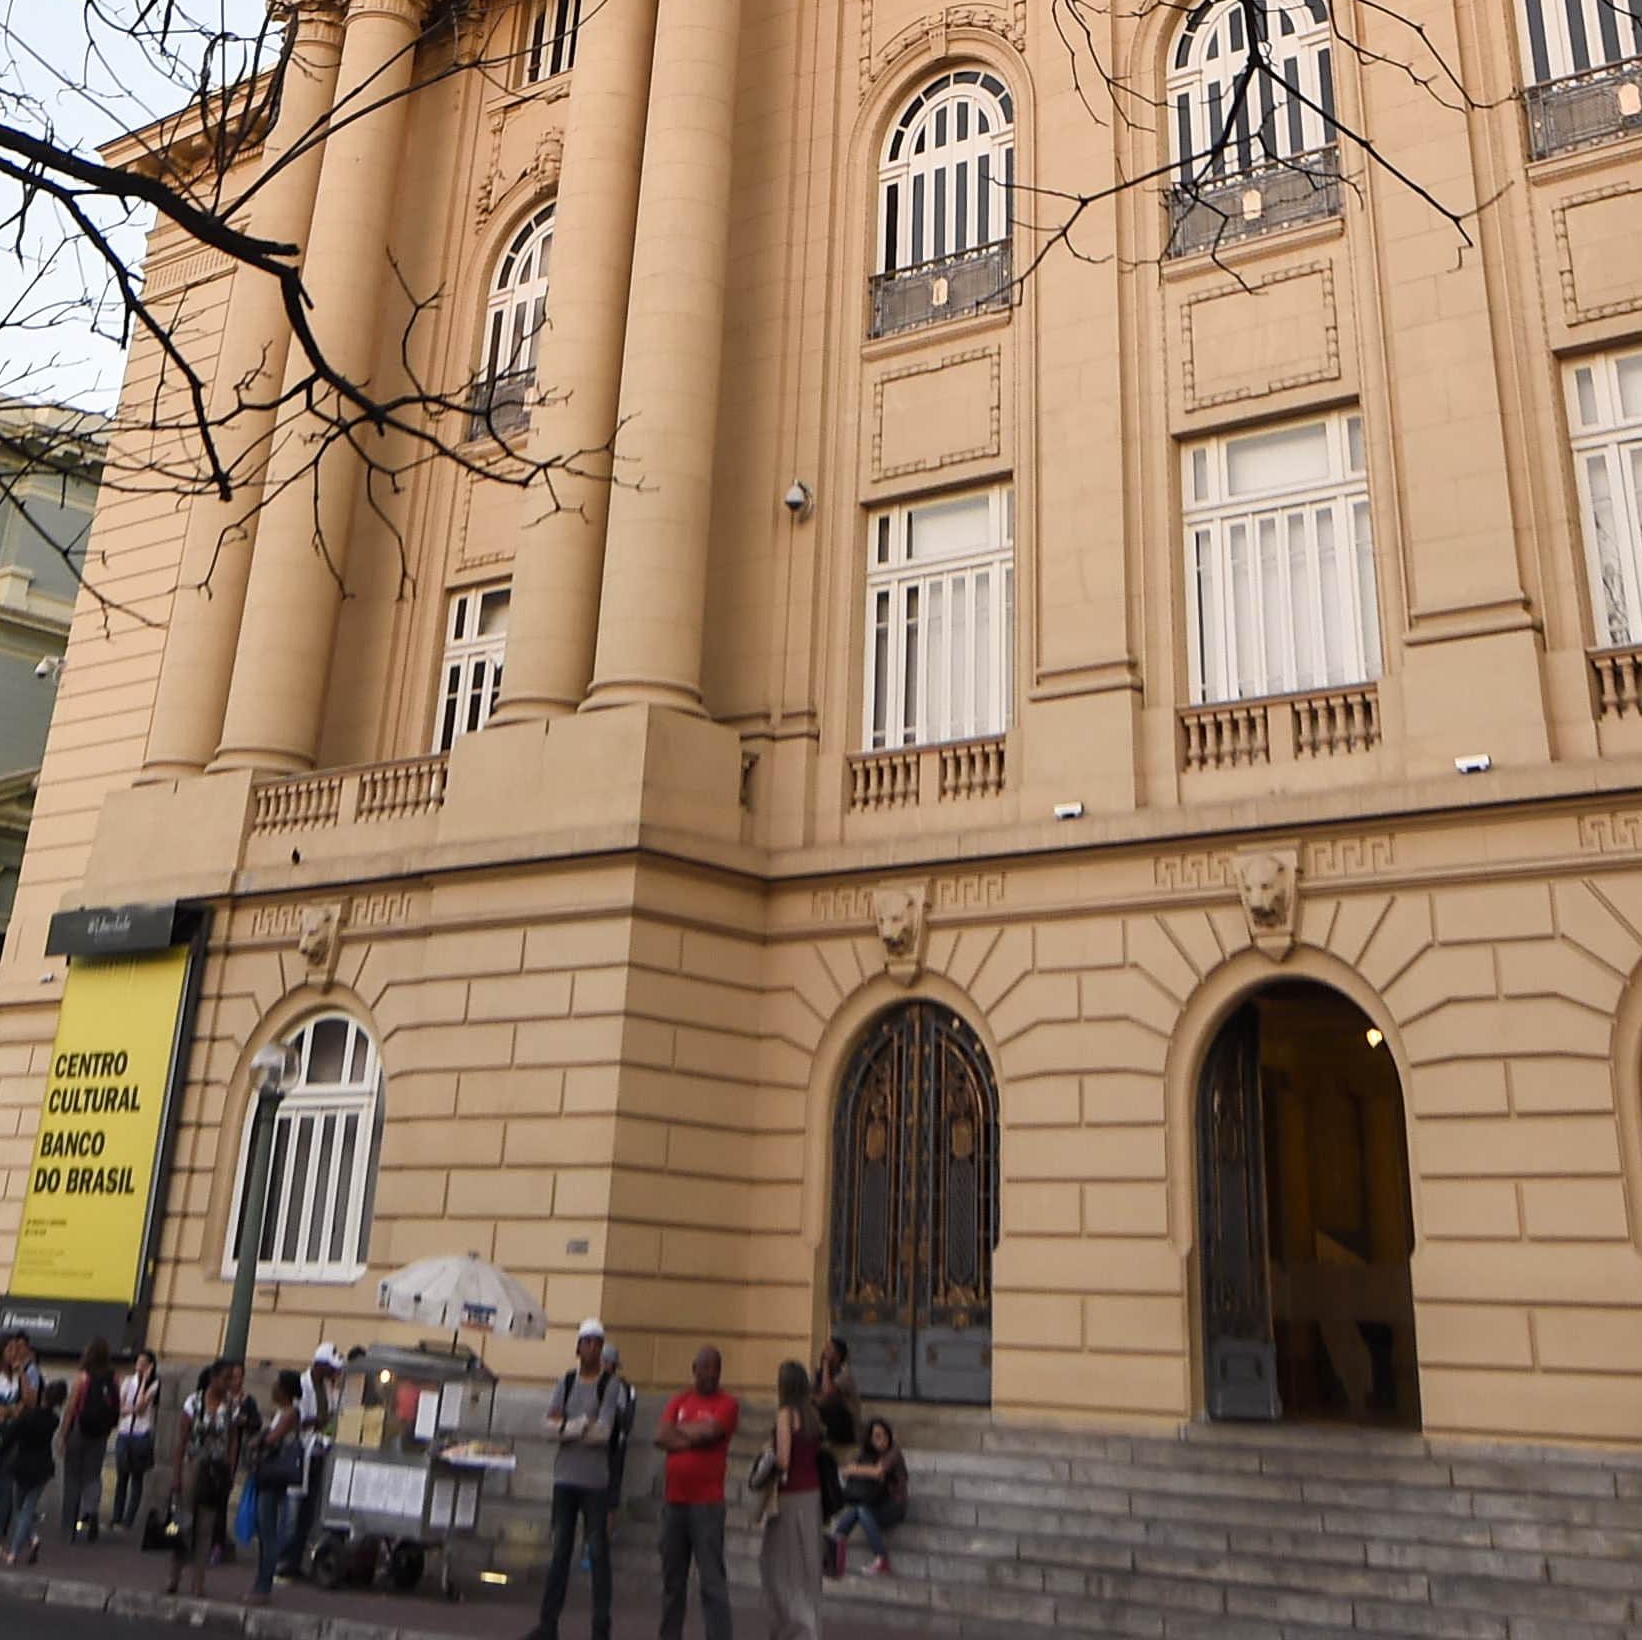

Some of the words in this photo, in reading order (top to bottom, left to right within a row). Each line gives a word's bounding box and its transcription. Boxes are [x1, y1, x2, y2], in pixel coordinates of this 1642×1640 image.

[55, 1050, 128, 1078] CENTRO
[48, 1085, 141, 1114] CULTURAL
[40, 1130, 105, 1158] BANCO
[33, 1167, 61, 1194] DO
[65, 1166, 135, 1195] BRASIL
